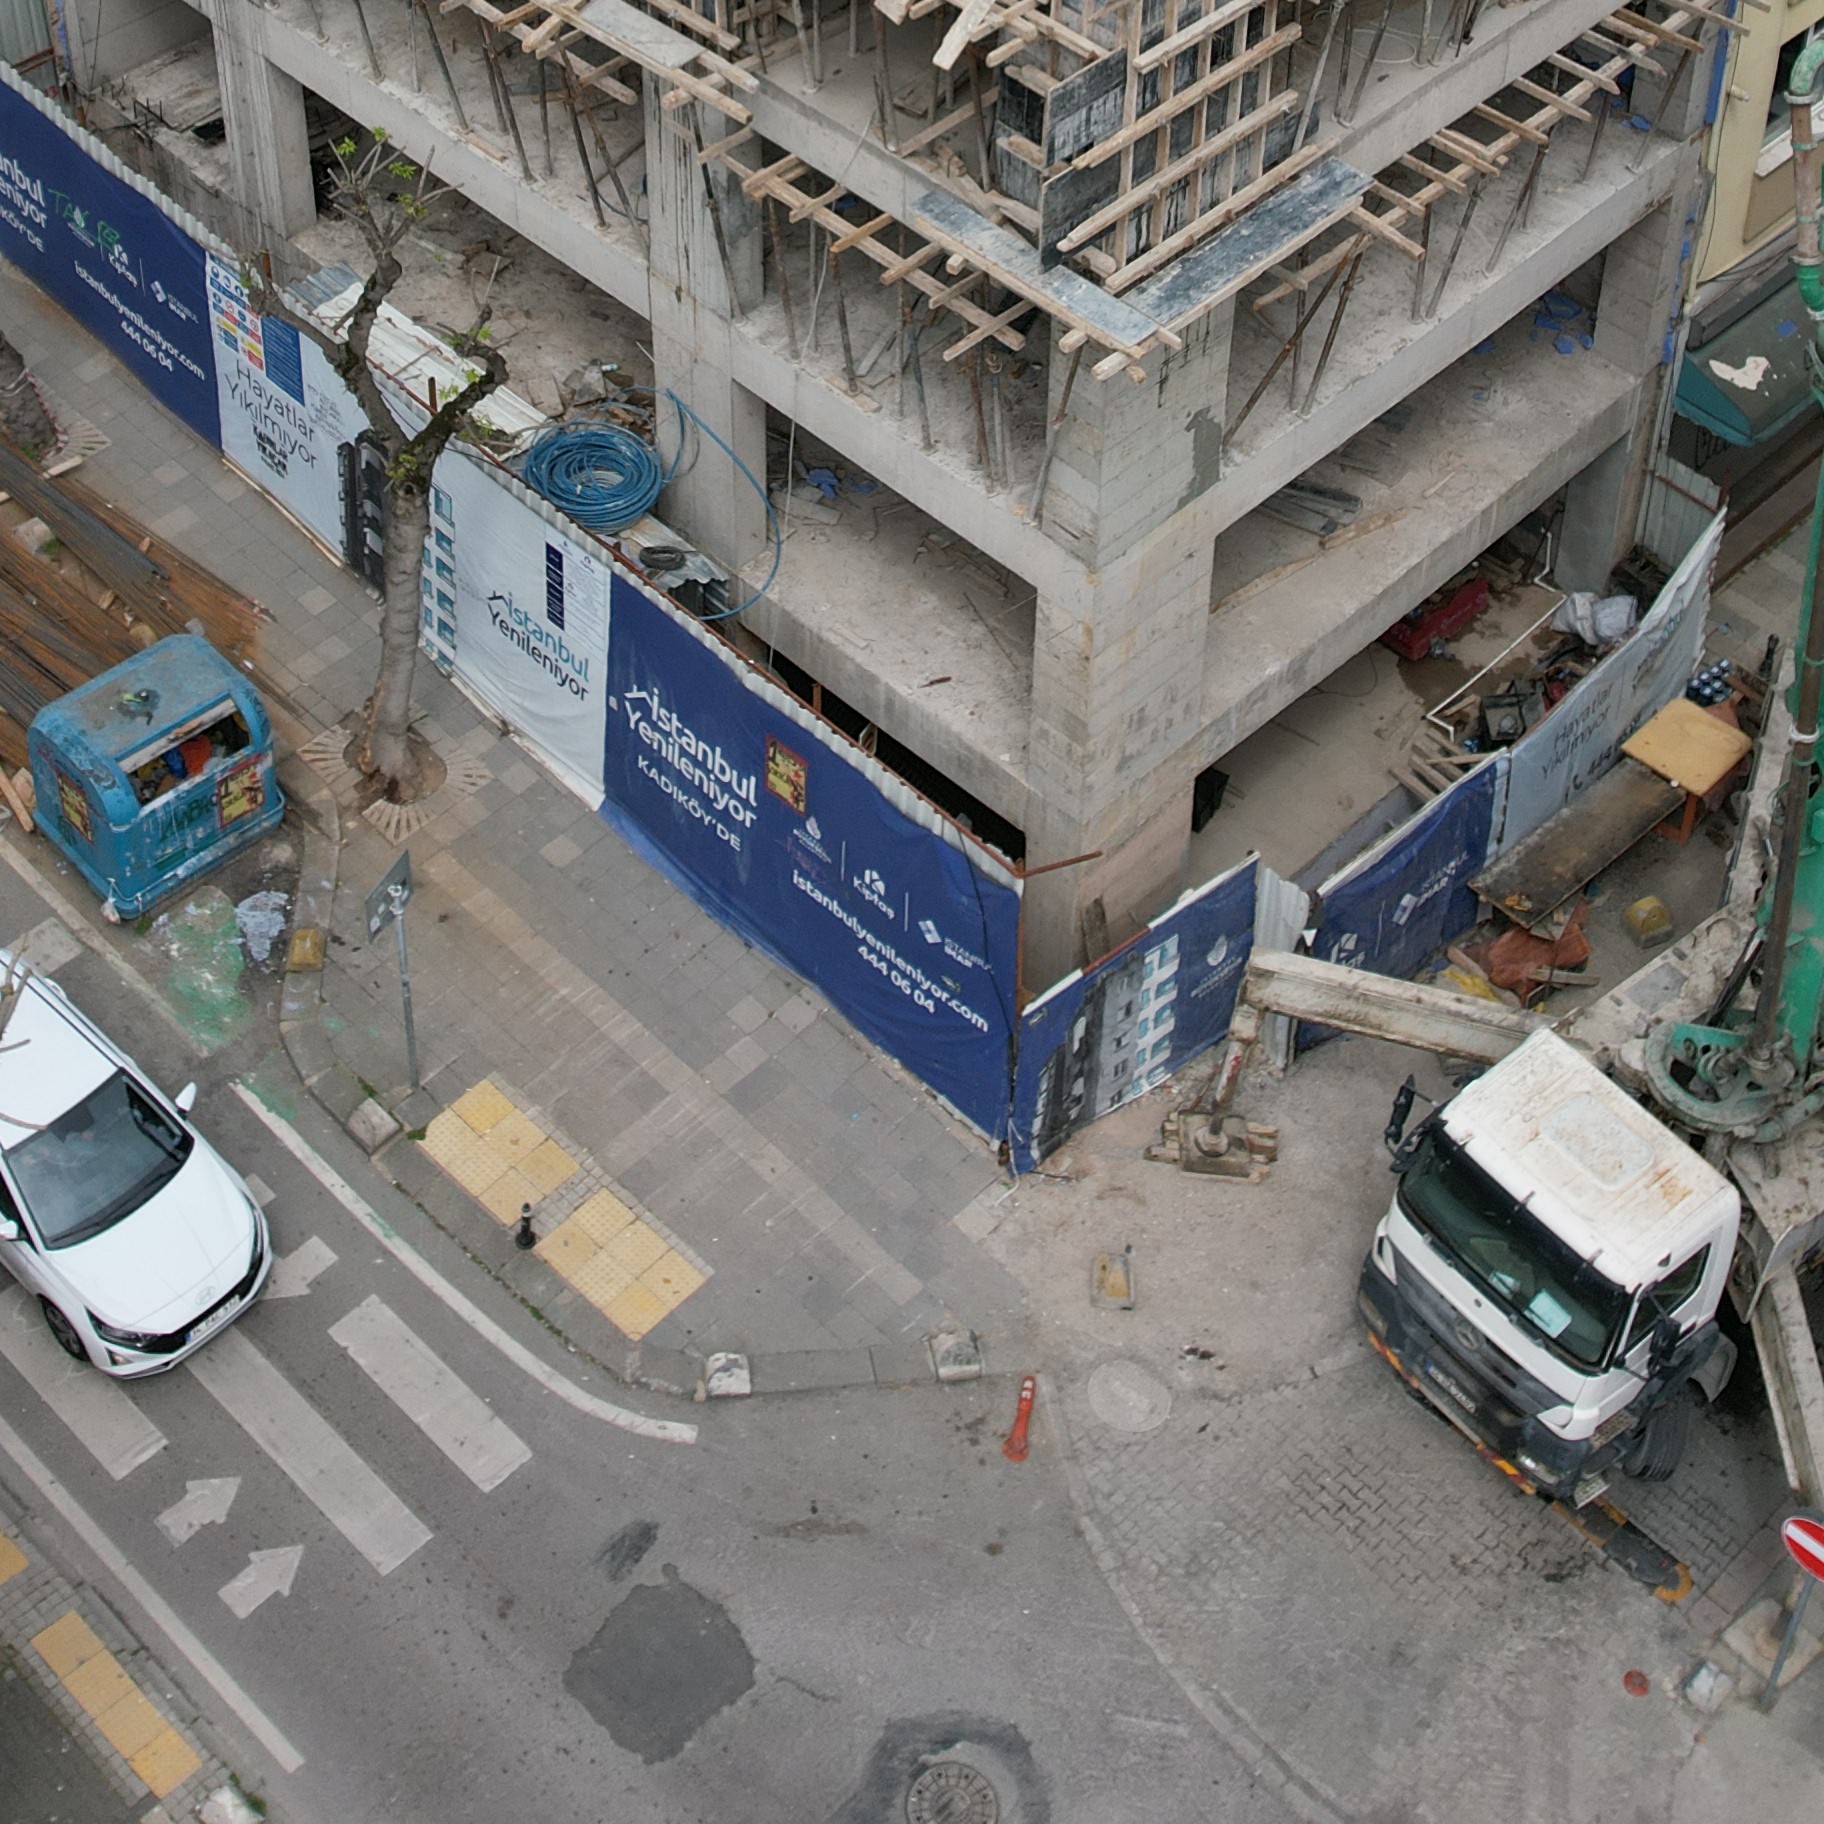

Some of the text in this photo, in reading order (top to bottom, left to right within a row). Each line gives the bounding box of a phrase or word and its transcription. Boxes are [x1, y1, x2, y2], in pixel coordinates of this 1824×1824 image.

[121, 321, 174, 373] 444 06 04
[225, 374, 318, 469] Yıkılmıyor
[236, 359, 315, 443] Hayatlar
[487, 603, 590, 701] Yenileniyor
[1554, 681, 1615, 750] Hayatlar
[624, 700, 758, 828] Yenileniyor
[637, 755, 741, 852] KADIKÖY'DE
[858, 945, 936, 1014] 444 06 04
